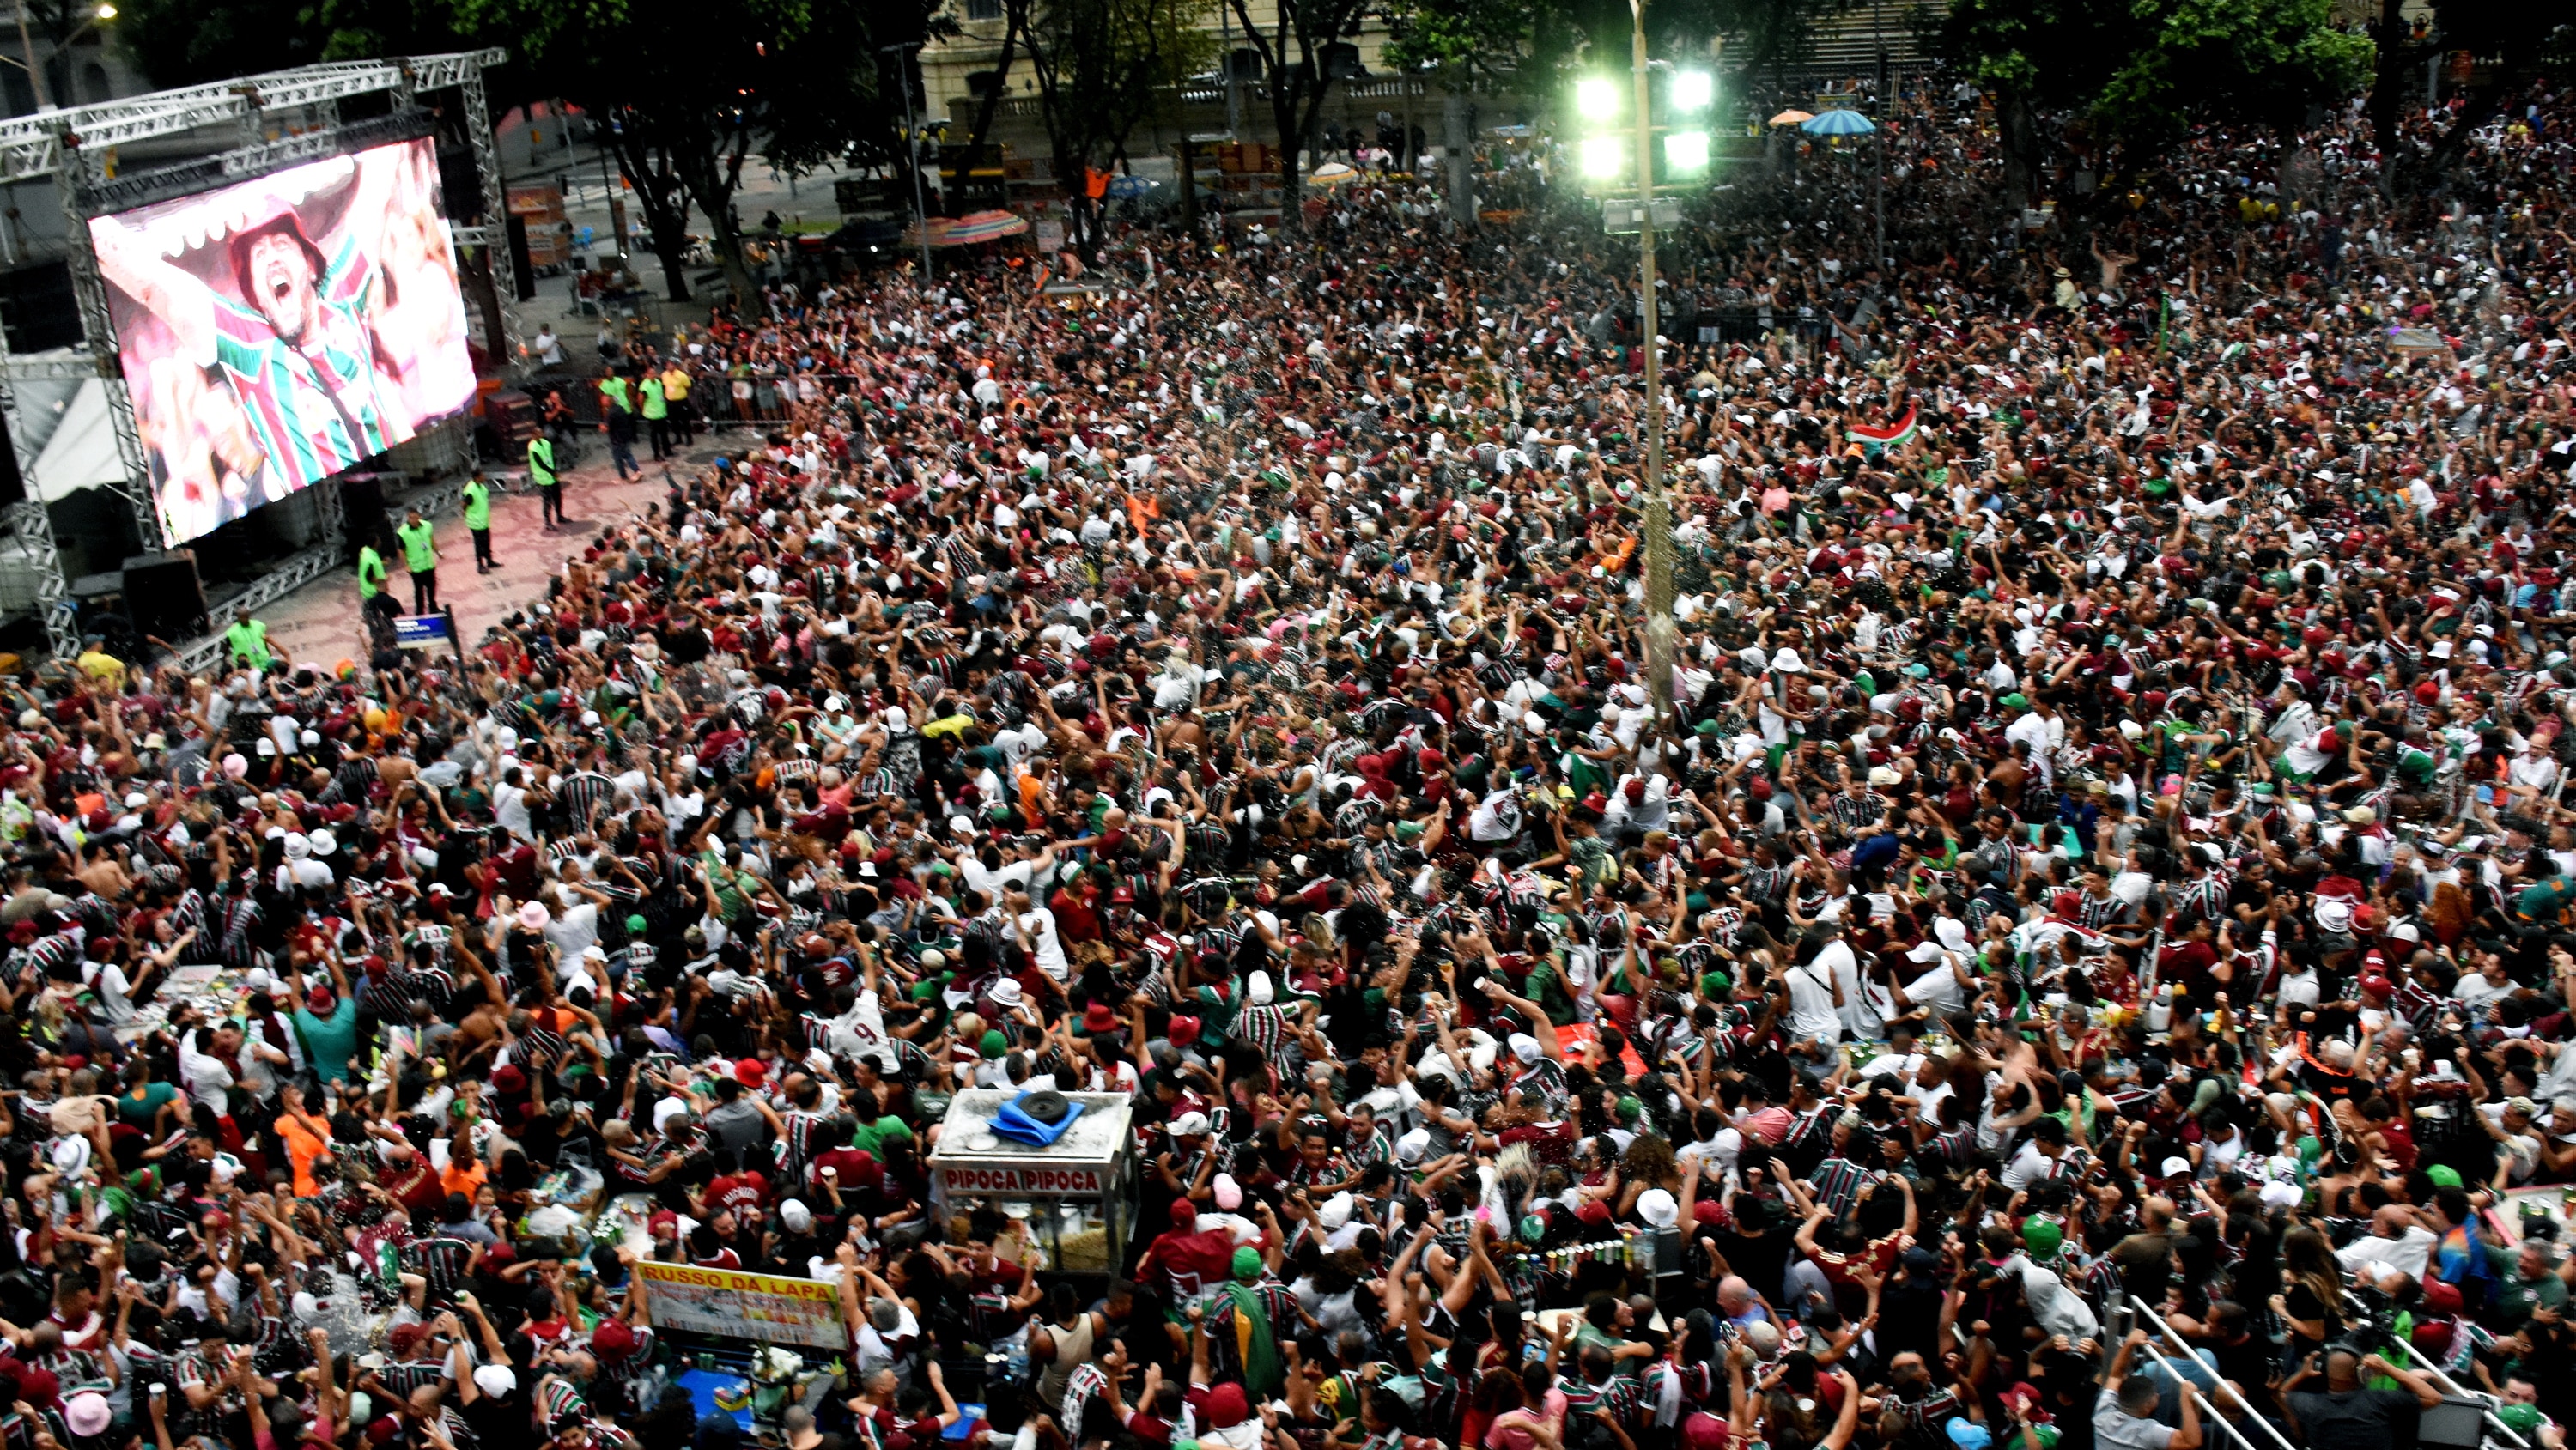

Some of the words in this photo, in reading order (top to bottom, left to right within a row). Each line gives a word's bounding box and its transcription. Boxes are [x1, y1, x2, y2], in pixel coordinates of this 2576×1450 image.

[854, 1022, 878, 1045] 9
[946, 1169, 1019, 1190] PIPOCA
[1025, 1171, 1099, 1191] PIPOCA
[644, 1265, 723, 1287] RUSSO
[732, 1277, 764, 1293] DA
[771, 1283, 831, 1301] LAPA
